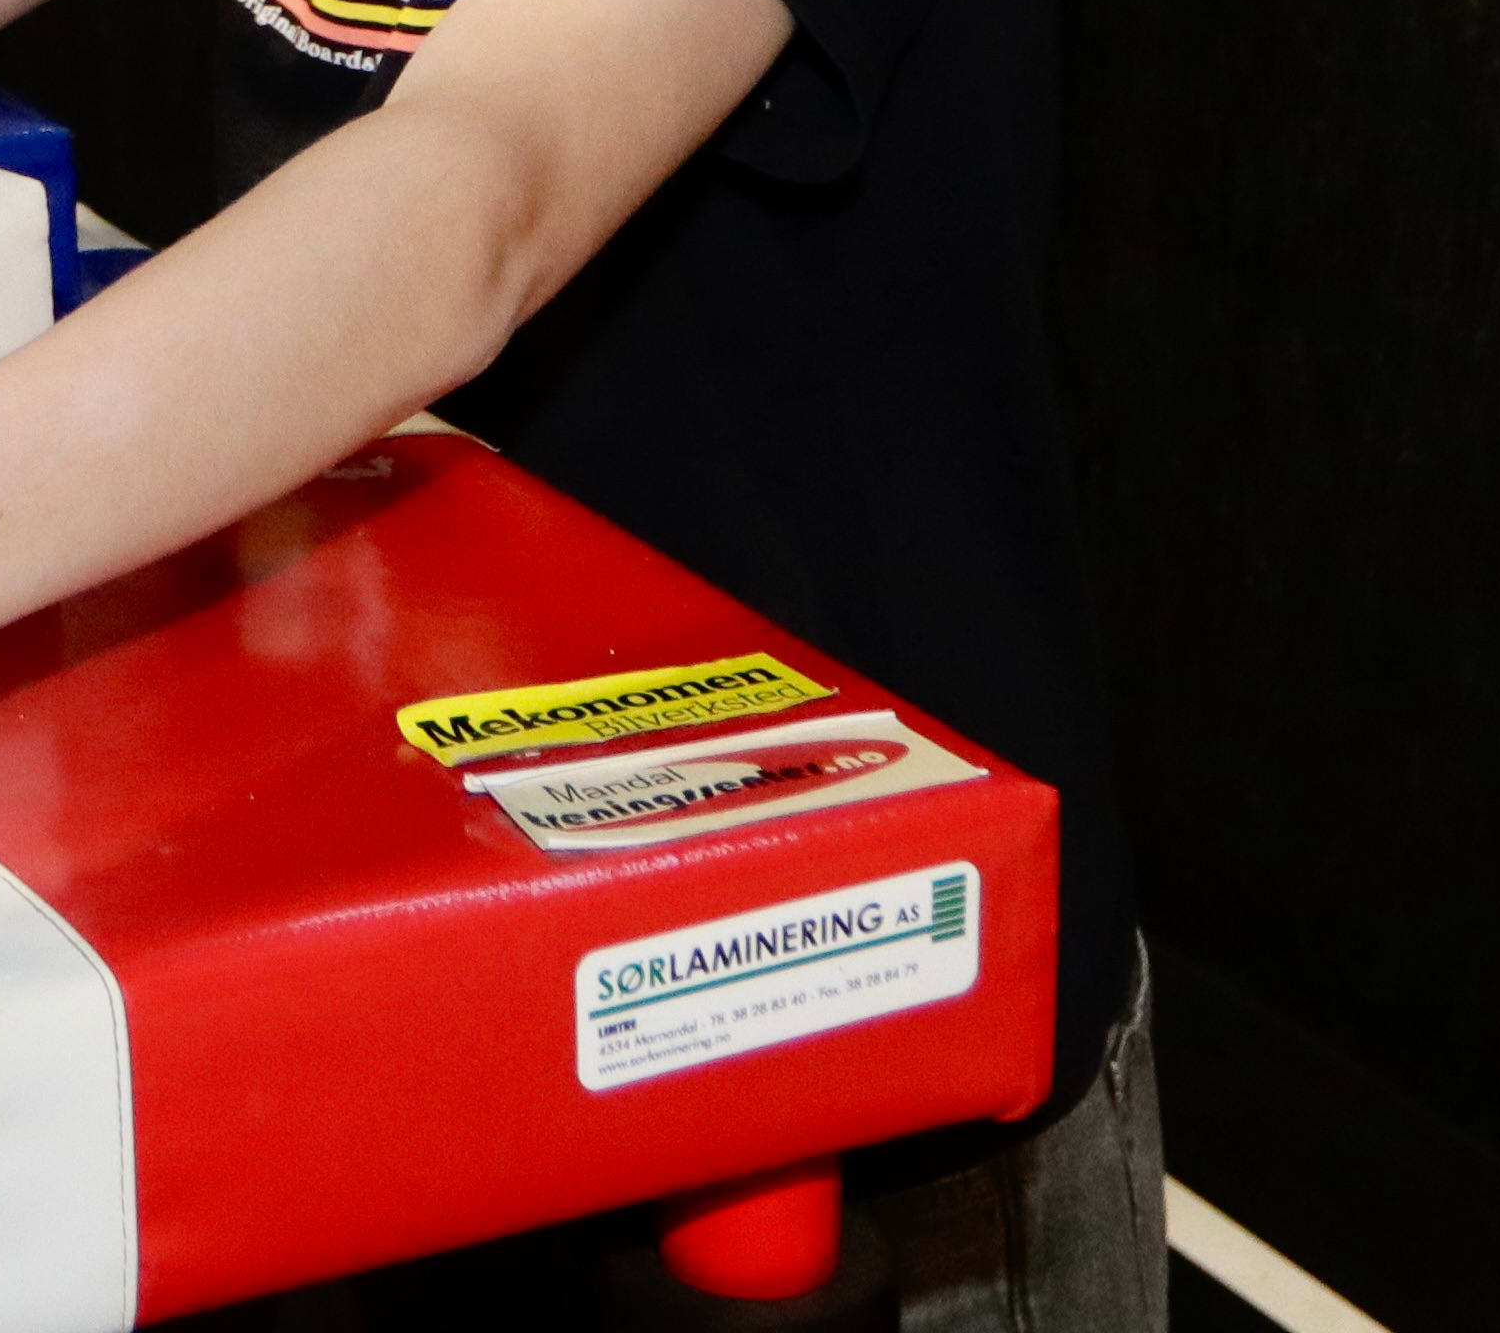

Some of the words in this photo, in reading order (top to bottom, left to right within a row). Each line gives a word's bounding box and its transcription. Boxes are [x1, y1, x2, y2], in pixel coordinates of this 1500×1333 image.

[417, 664, 784, 748] Mekonomen
[586, 683, 805, 740] Bilverksted
[543, 767, 686, 804] Mandal
[597, 902, 883, 1001] SØRLAMINERING
[896, 904, 920, 926] AS
[732, 1008, 748, 1023] 38
[752, 1004, 767, 1019] 28
[792, 994, 807, 1008] 40
